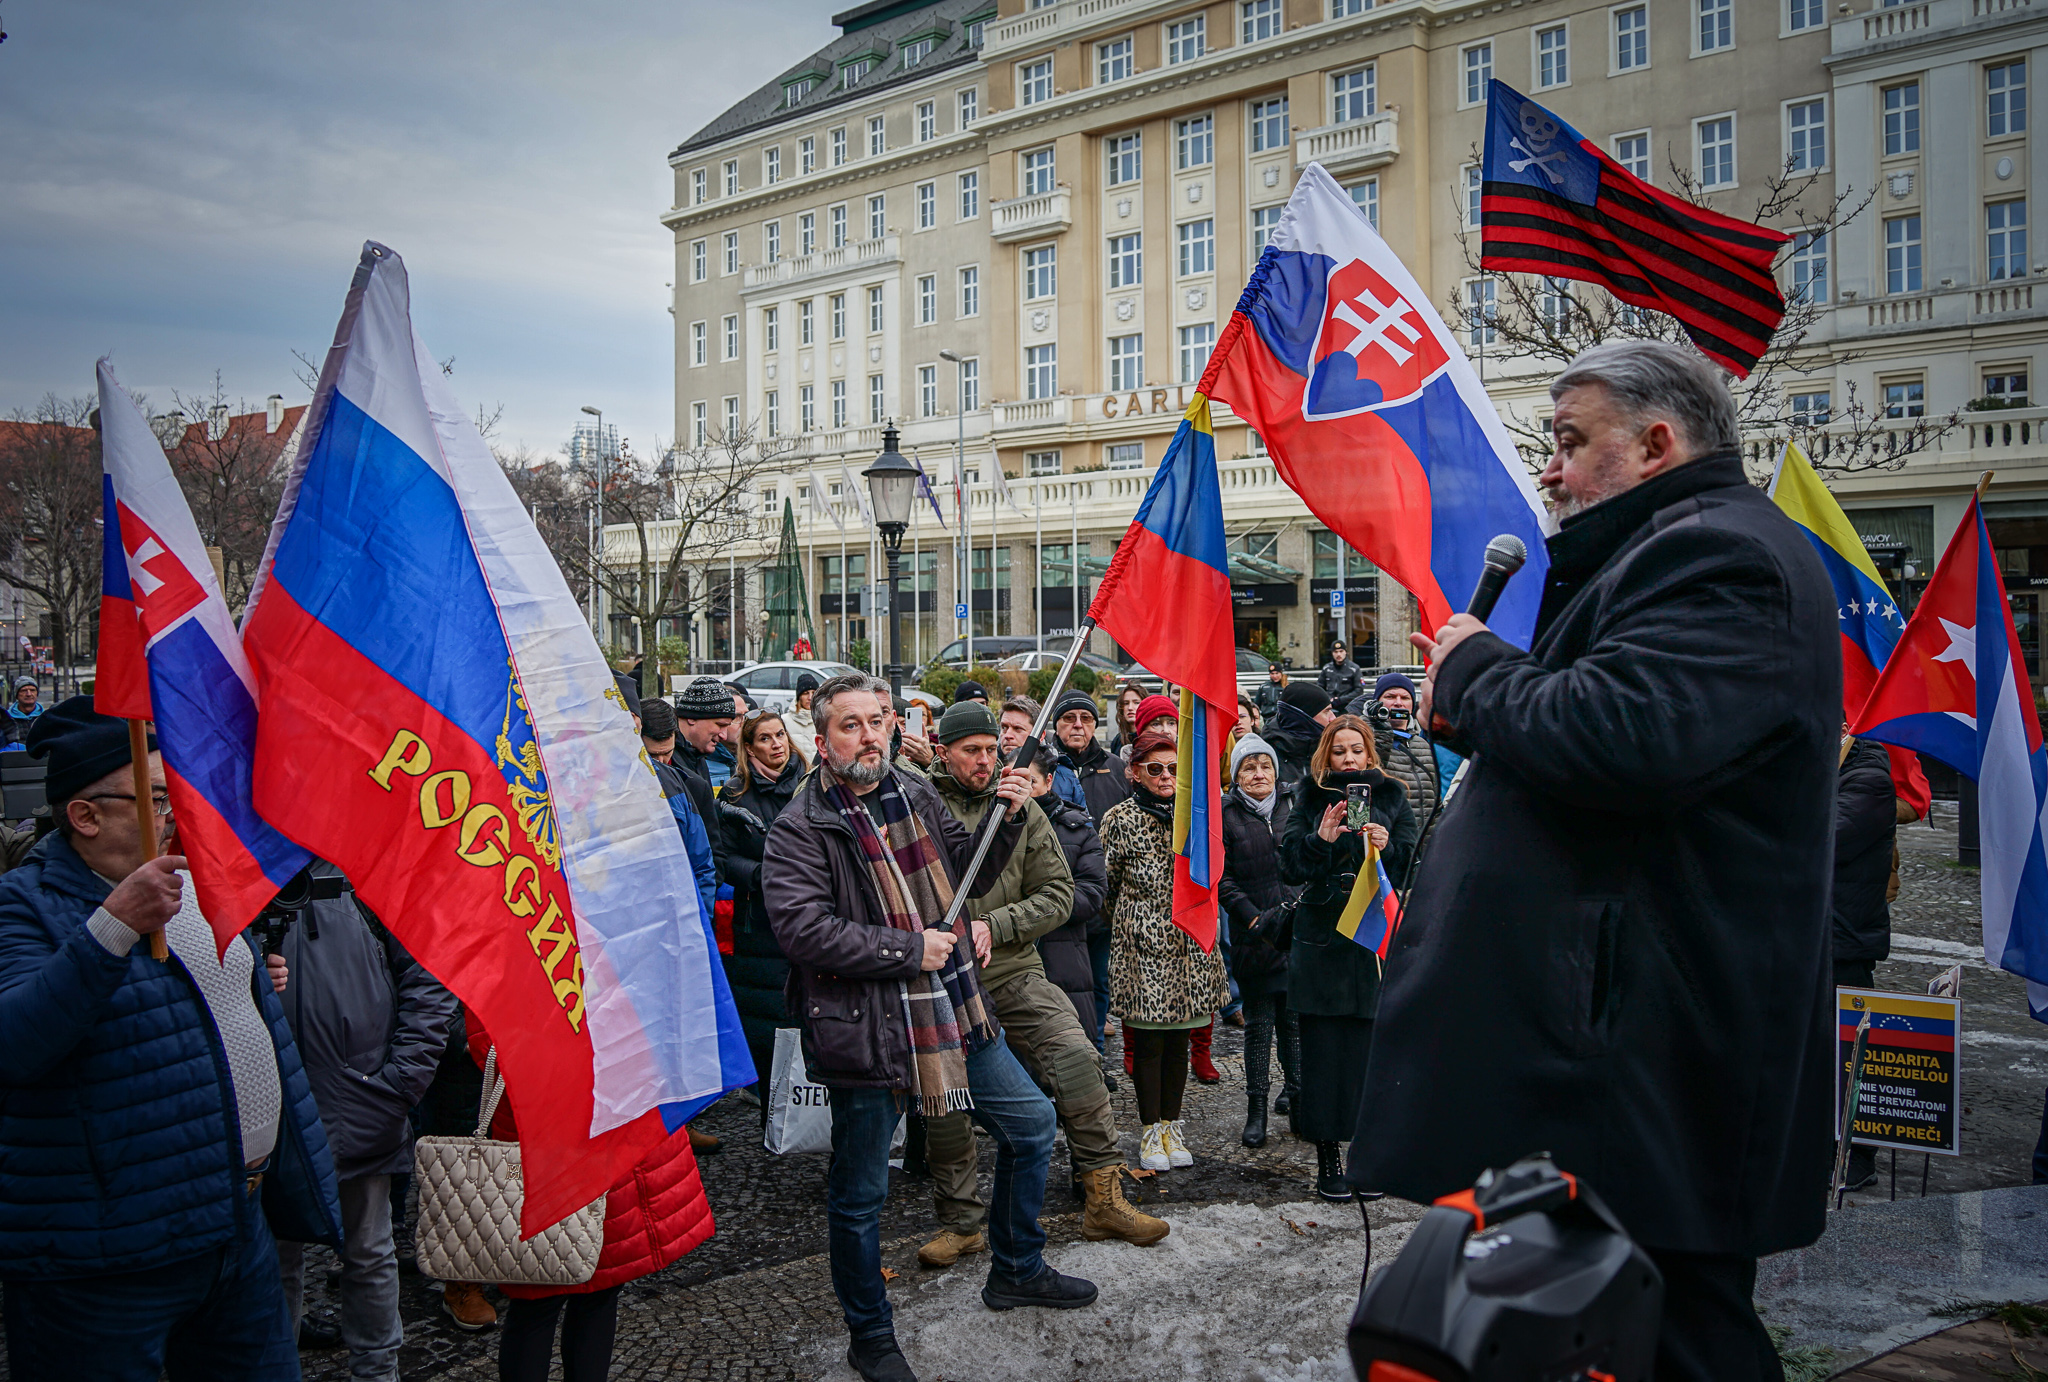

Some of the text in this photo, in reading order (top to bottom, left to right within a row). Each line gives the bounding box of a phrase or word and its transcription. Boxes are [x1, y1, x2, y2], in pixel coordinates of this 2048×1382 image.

[1102, 387, 1190, 418] CARL
[1860, 534, 1890, 543] SAVOY
[1332, 592, 1341, 606] P
[957, 605, 965, 617] P
[1864, 1049, 1940, 1069] OLIDARITA
[1860, 1082, 1916, 1097] NIE VOJNE!
[1860, 1093, 1946, 1112] NIE PREVRATOM!
[1859, 1104, 1938, 1122] NIE SANKCIÁM!
[1853, 1120, 1941, 1142] RUKY PREČ!
